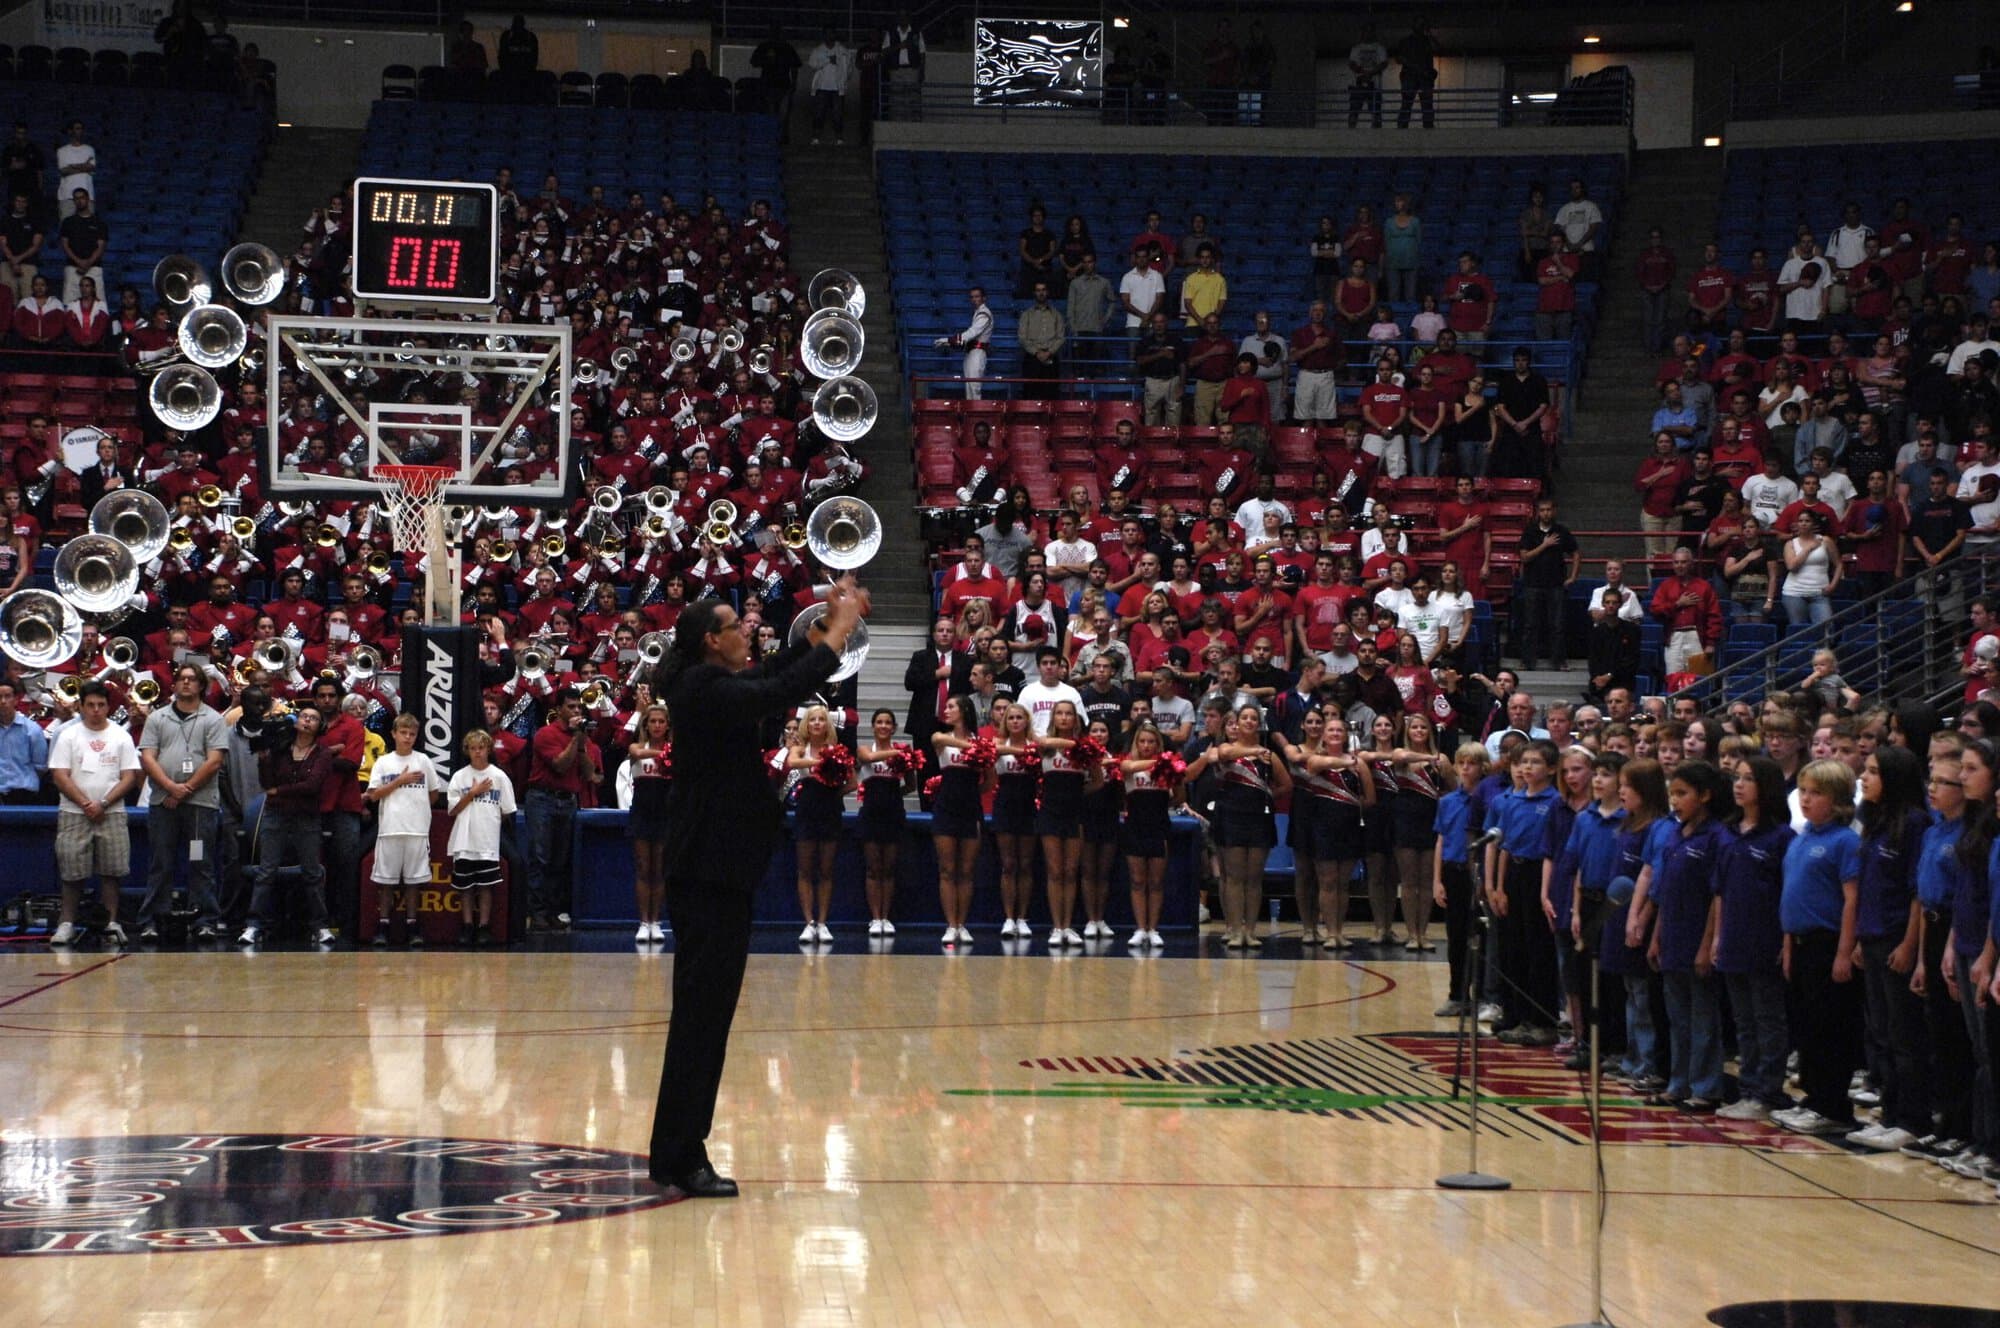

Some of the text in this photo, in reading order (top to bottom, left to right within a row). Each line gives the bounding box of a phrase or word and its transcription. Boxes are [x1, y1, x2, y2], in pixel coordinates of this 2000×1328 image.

[371, 191, 454, 225] 00.0
[387, 237, 461, 289] 00
[75, 434, 100, 445] YAMAHA
[1032, 701, 1057, 714] ARIZ
